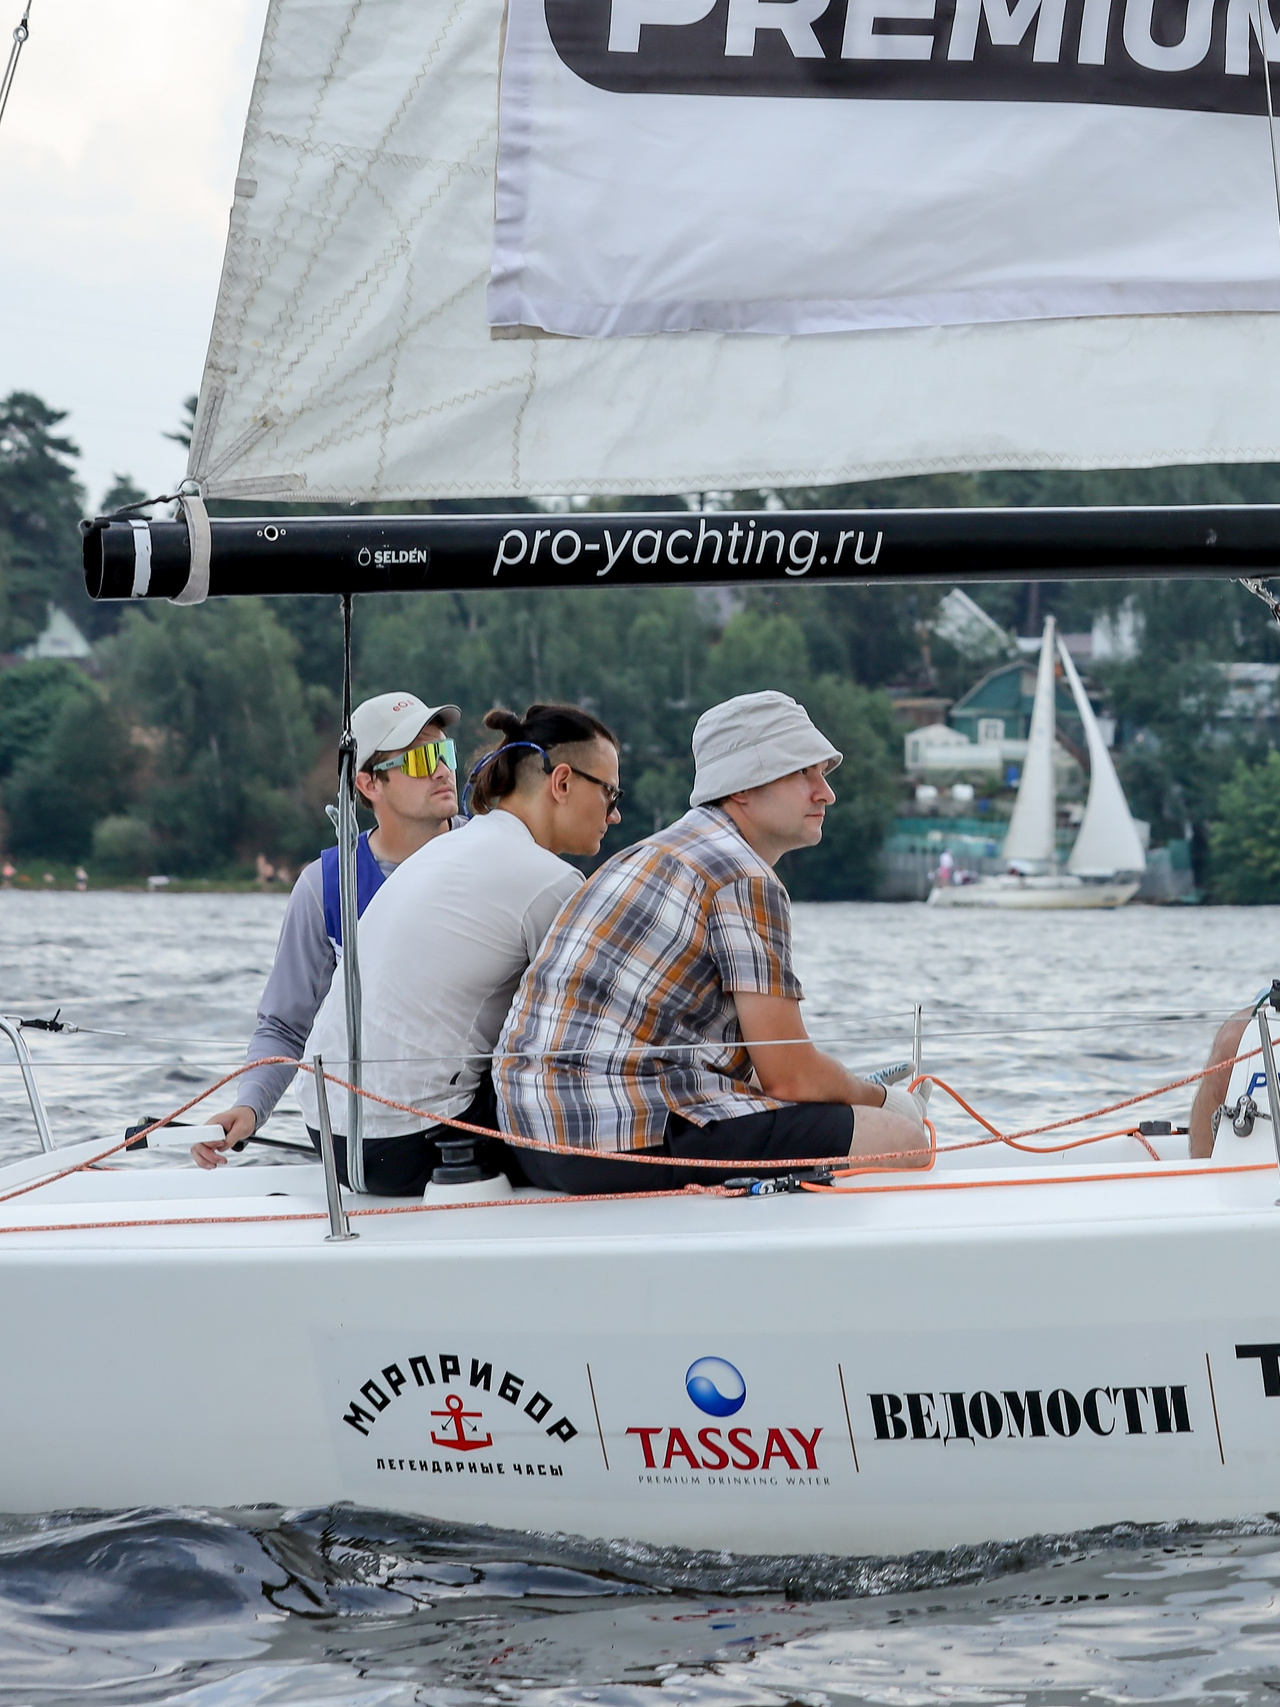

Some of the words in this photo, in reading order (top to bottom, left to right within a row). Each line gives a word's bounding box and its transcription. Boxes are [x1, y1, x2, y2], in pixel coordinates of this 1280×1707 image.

[373, 547, 427, 564] SELDÉN
[493, 519, 884, 576] pro-yachting.ru
[343, 1354, 578, 1443] МОРПРИБОР
[866, 1385, 1194, 1446] ВЕДОМОСТИ
[376, 1458, 505, 1474] ЛЕГЕНДАРНЫЕ
[513, 1463, 564, 1476] ЧАСЫ
[625, 1427, 824, 1470] TASSAY
[638, 1475, 700, 1485] PREMIUM
[708, 1476, 778, 1486] DRINKING
[786, 1476, 831, 1486] WATER
